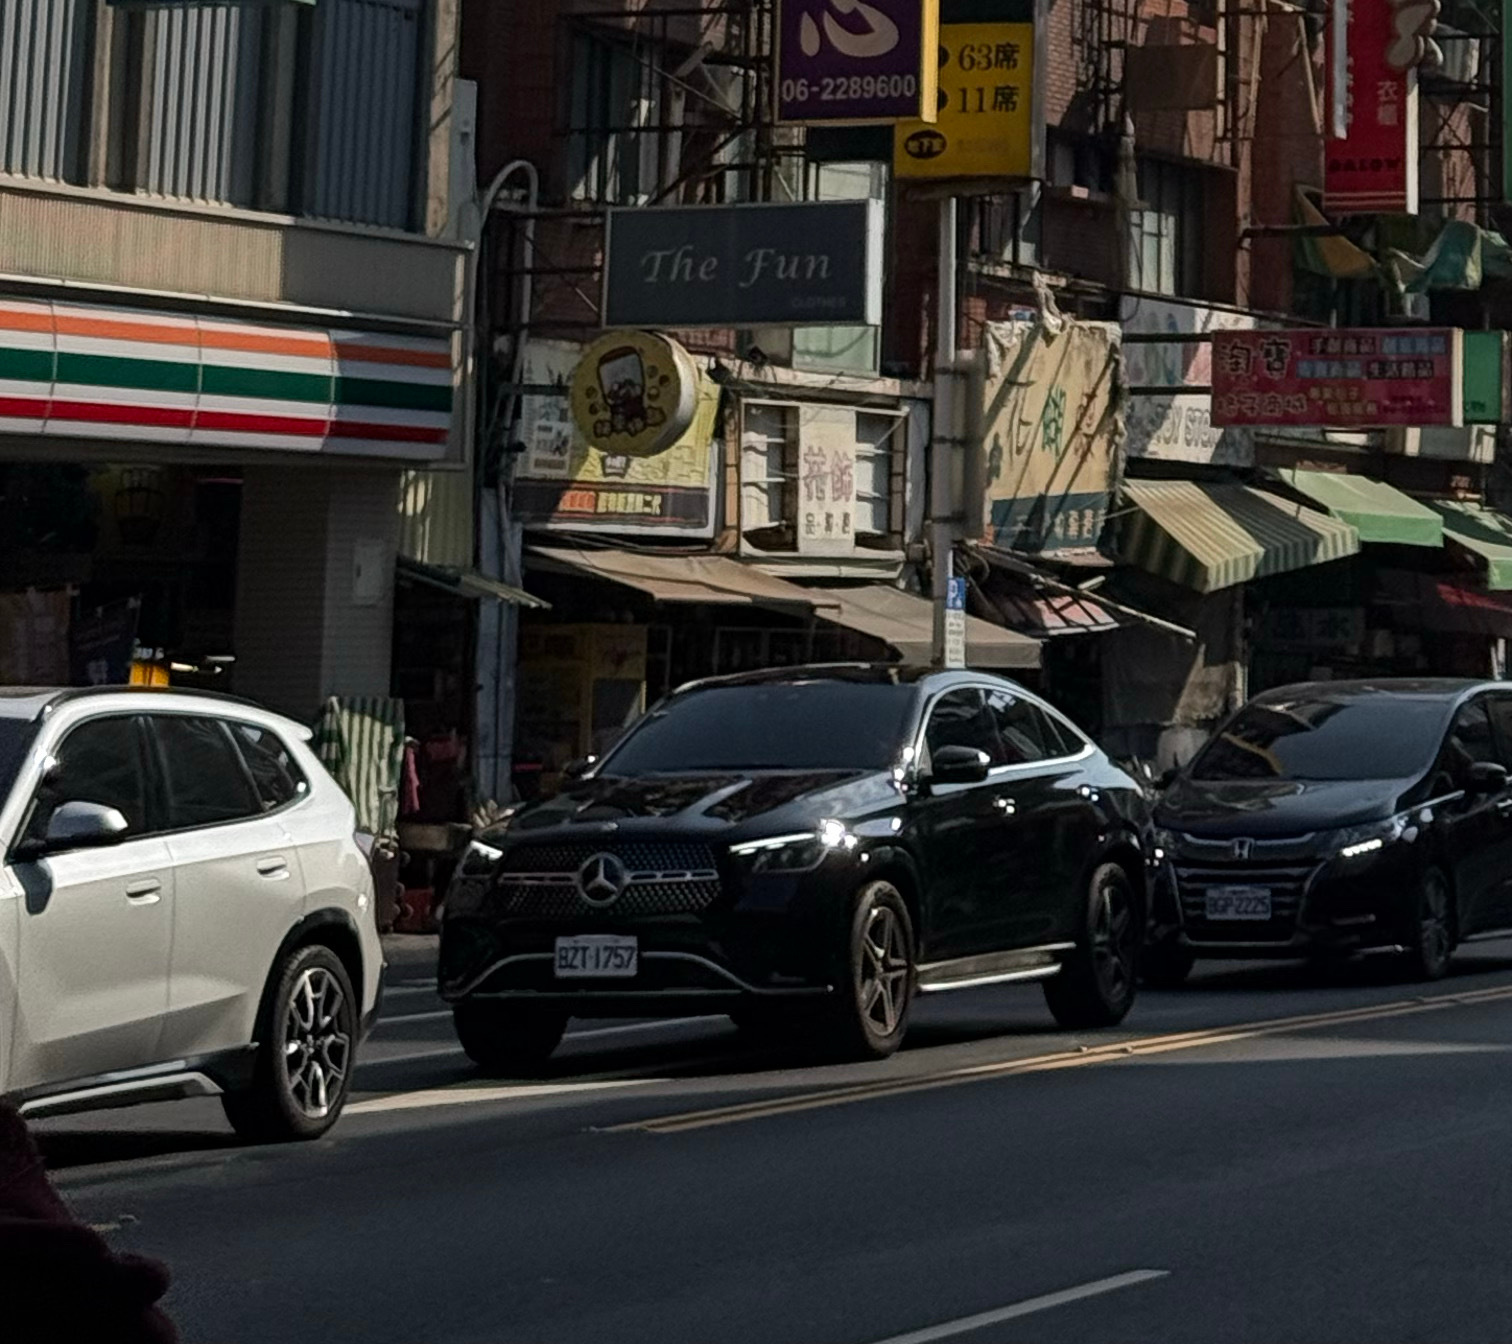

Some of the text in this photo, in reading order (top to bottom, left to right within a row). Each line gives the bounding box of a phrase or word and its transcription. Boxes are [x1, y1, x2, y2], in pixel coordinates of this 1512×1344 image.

[781, 74, 917, 102] 06-2289600
[640, 244, 832, 289] The Fun
